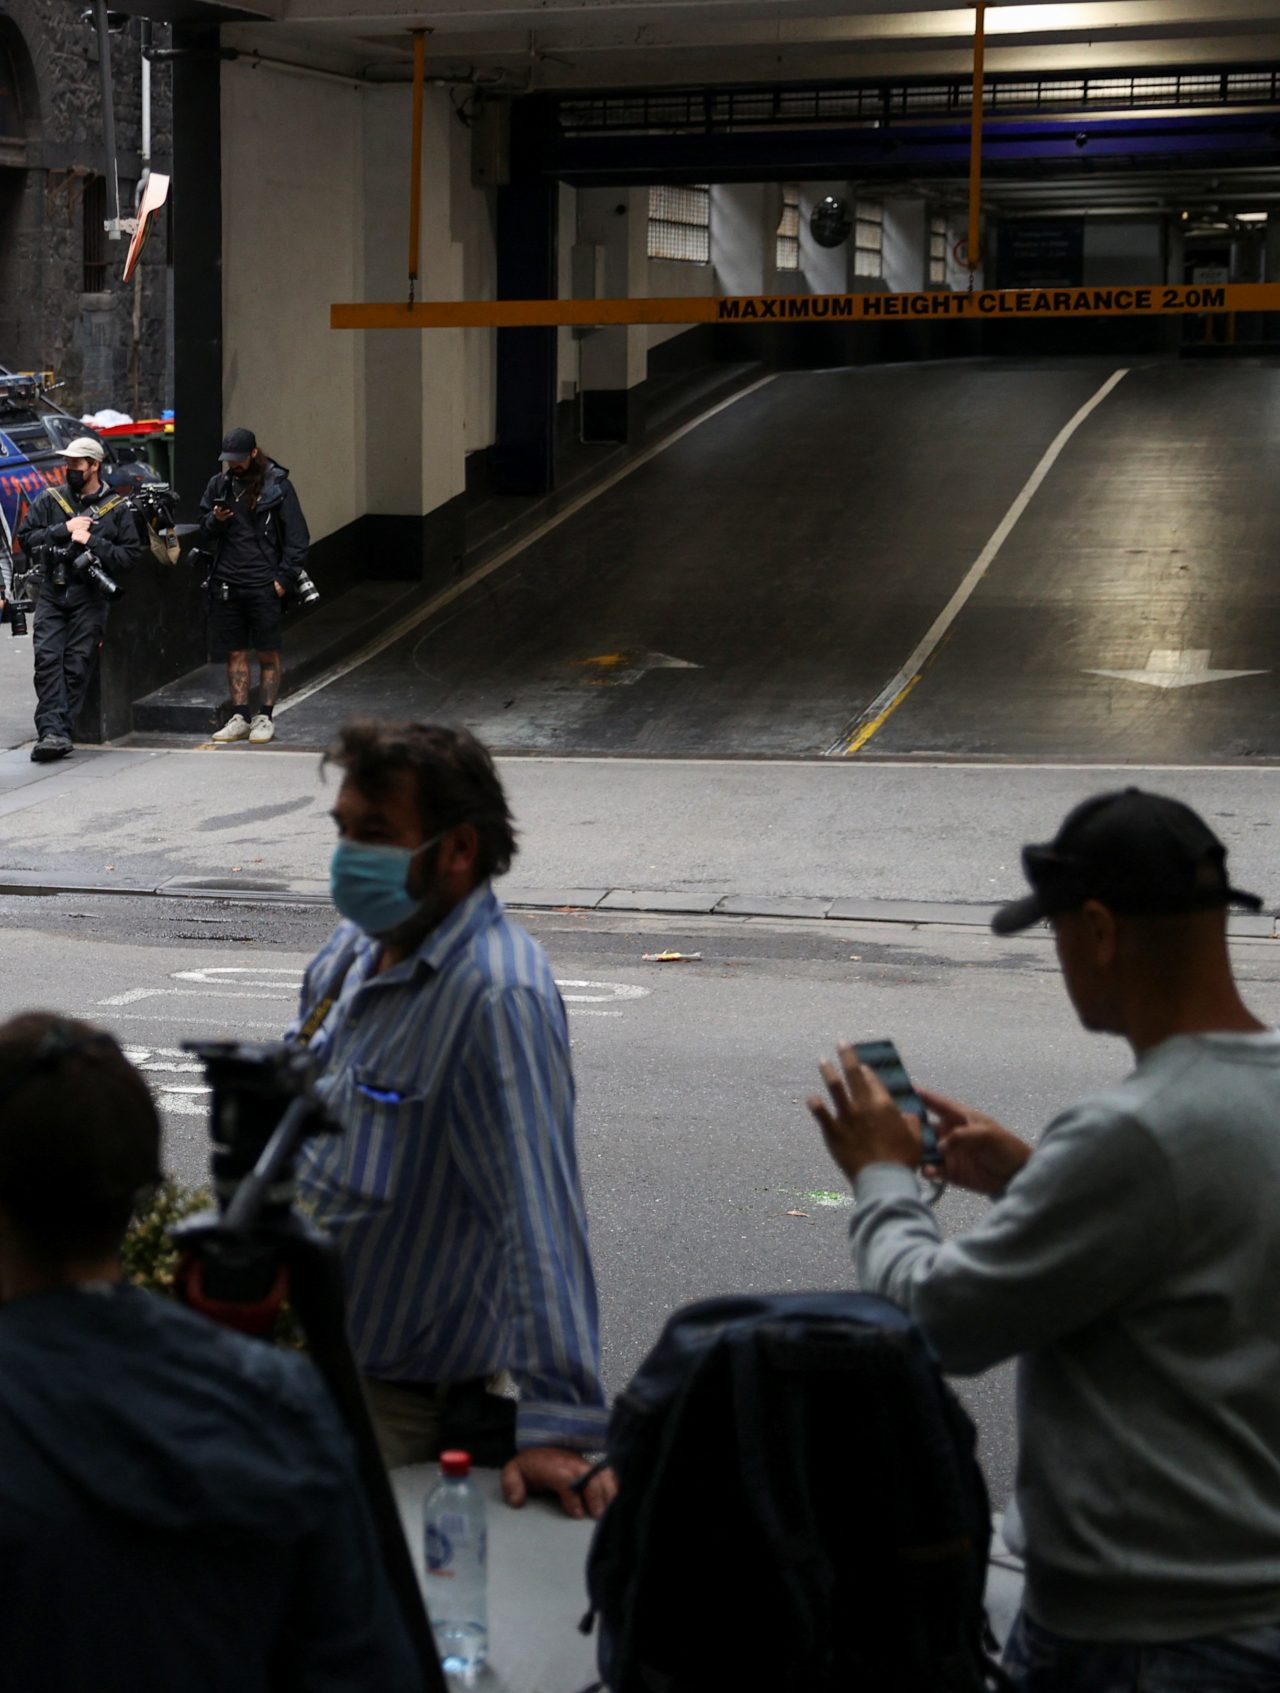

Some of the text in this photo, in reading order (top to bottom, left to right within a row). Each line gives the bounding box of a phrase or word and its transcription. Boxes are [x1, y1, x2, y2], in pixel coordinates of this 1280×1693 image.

[720, 288, 1225, 318] MAXIMUM HEIGHT CLEARANCE 2.0M
